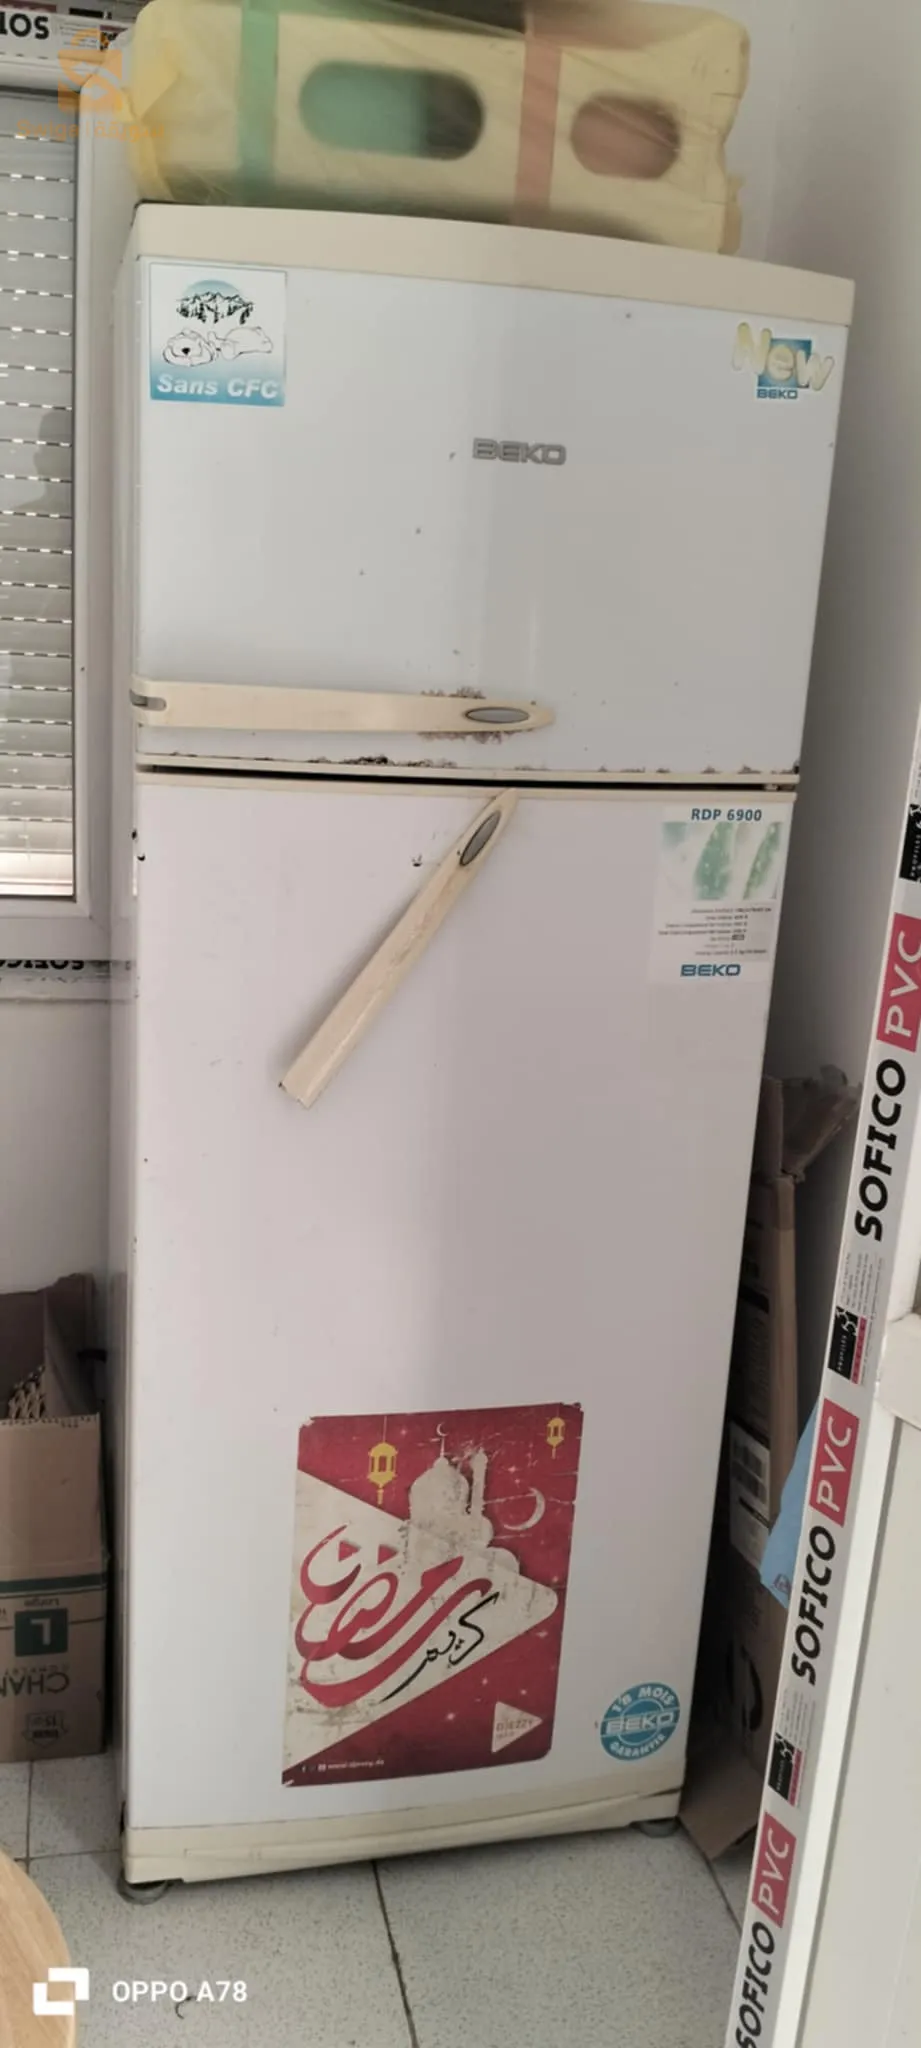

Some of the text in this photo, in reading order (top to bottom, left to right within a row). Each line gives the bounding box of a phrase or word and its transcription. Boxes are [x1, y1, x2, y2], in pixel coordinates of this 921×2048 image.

[731, 322, 835, 391] New
[157, 373, 279, 400] Sans CFC
[757, 389, 798, 400] BEKO
[472, 437, 567, 466] BEKO
[691, 808, 762, 822] RDP 6900
[680, 964, 741, 977] BEKO
[855, 1059, 906, 1241] SOFICO
[885, 930, 921, 1037] PVC
[791, 1526, 836, 1686] SOFICO
[817, 1416, 852, 1513] PVC
[30, 1618, 51, 1646] L
[611, 1686, 675, 1712] 18 MOIS
[606, 1711, 674, 1735] BEKO
[736, 1828, 789, 2048] SOFICO PVC
